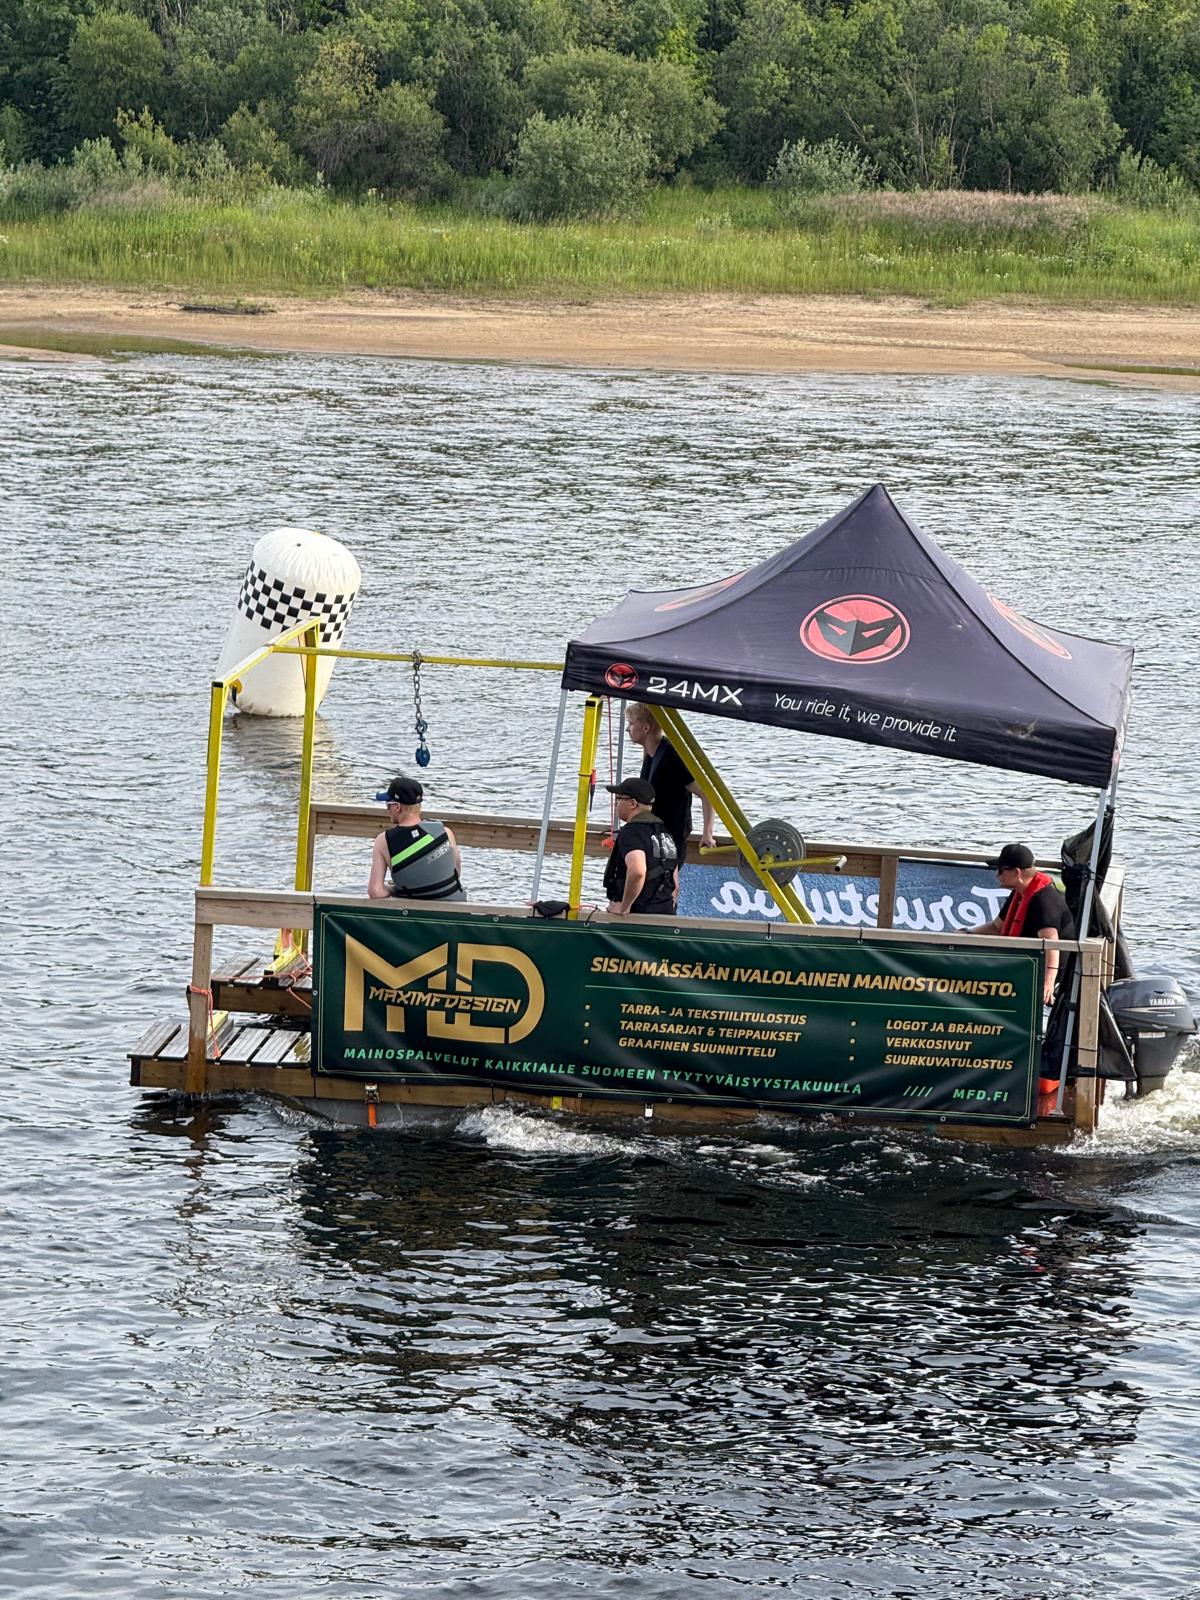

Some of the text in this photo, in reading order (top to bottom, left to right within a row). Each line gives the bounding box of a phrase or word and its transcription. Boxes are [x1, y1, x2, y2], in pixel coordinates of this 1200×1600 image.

[646, 676, 743, 706] 24MX
[774, 693, 803, 711] You
[805, 699, 836, 717] ride
[838, 703, 851, 723] it,
[857, 709, 881, 726] we
[881, 714, 941, 738] provide
[590, 956, 1017, 997] SISIMMÄSSÄÄN IVALOLAINEN MAINOSTOIMISTO.
[1149, 998, 1176, 1006] YAMAHA
[620, 1003, 807, 1025] TARRA- JA TEKSTIILITULOSTUS
[620, 1020, 802, 1042] TARRASARJAT & TEIPPAUKSET
[886, 1019, 1004, 1036] LOGOT JA BRÄNDIT
[618, 1037, 777, 1058] GRAAFINEN SUUNNITTELU
[886, 1036, 972, 1051] VERKKOSIVUT
[343, 1048, 863, 1095] MAINOSPALVELUT KAIKKIALLE SUOMEEN TYYTYVÄISYYSTAKUULLA
[884, 1054, 1014, 1070] SUURKUVATULOSTUS
[952, 1088, 1009, 1102] MFD.FI
